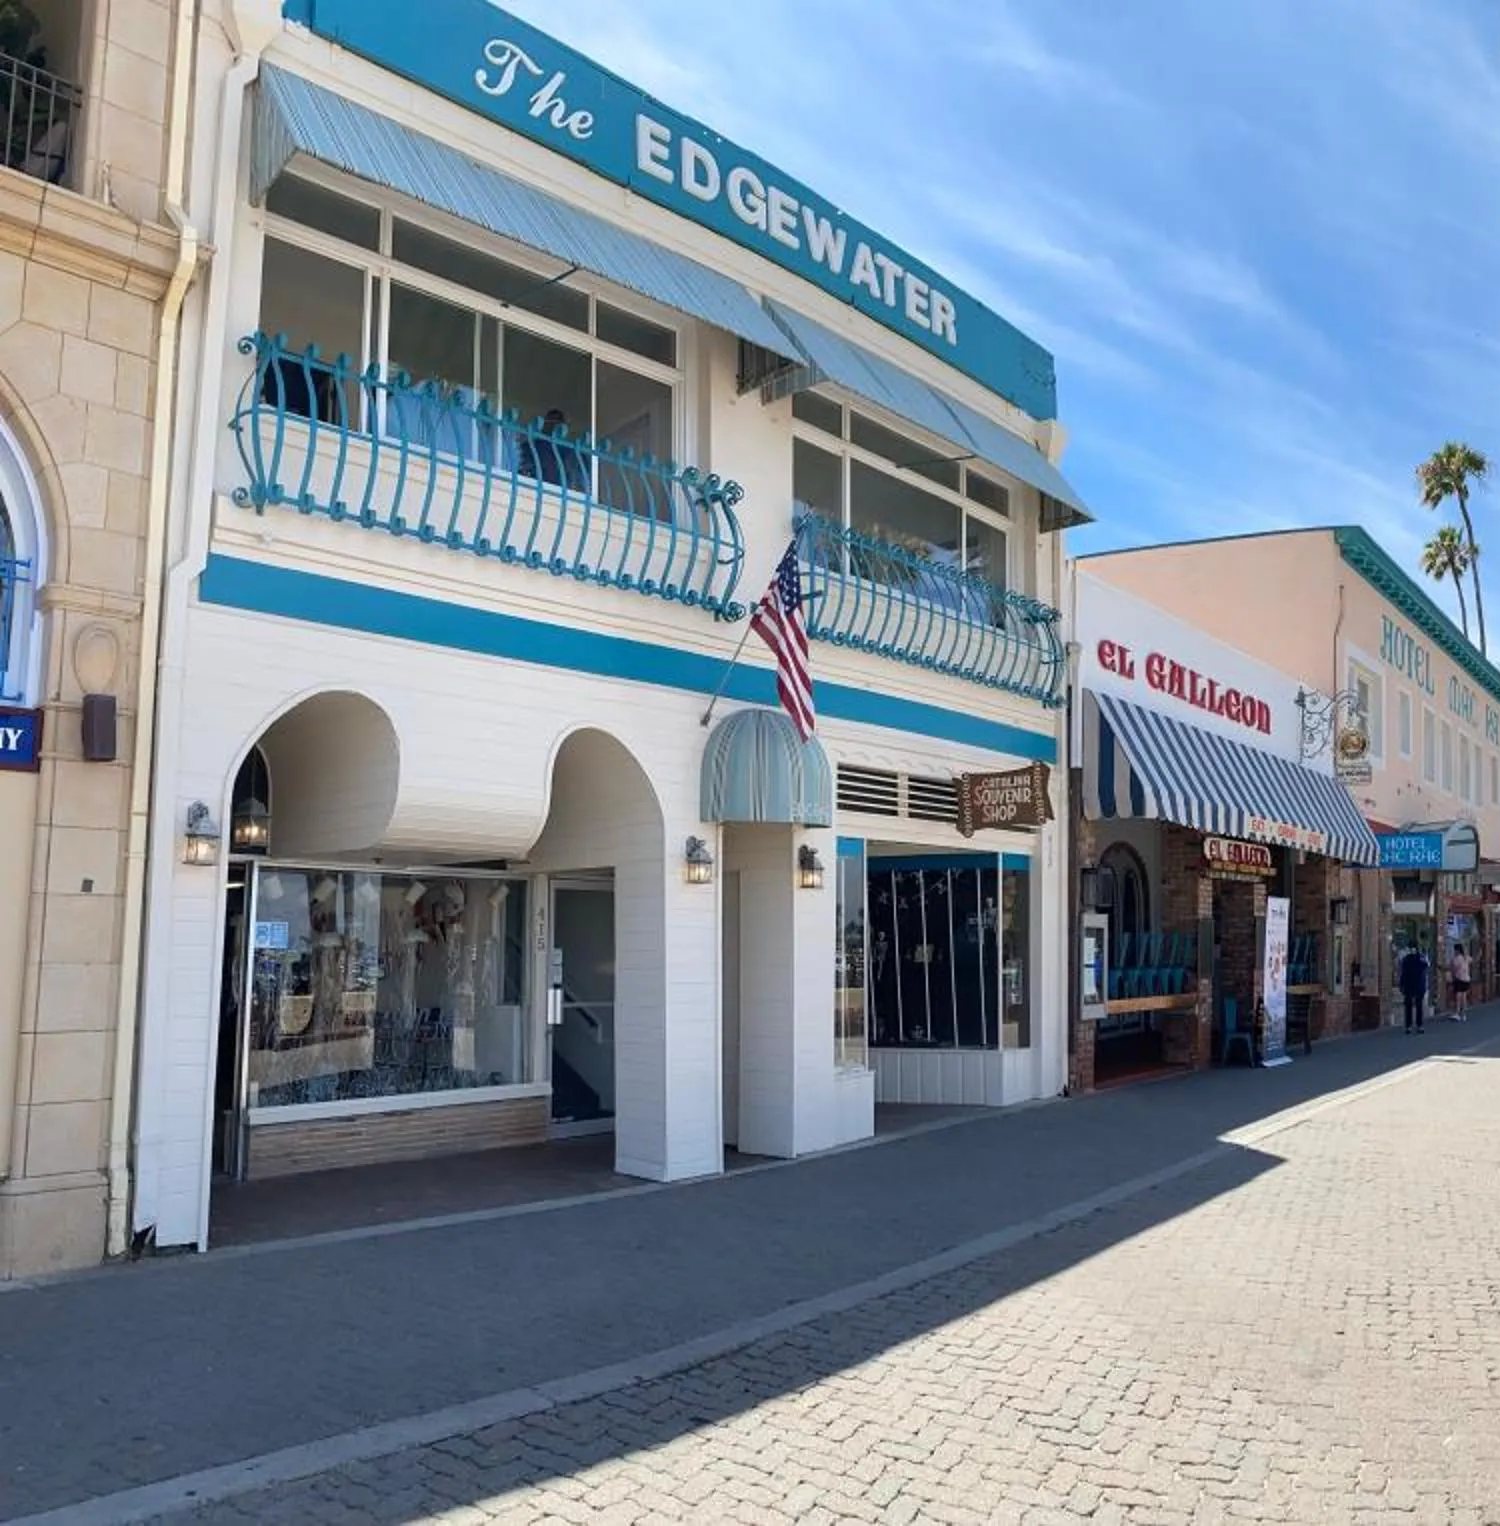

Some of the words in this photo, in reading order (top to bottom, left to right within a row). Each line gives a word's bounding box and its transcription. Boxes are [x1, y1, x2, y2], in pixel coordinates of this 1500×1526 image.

[475, 38, 593, 140] The
[635, 112, 958, 347] EDGEWATER
[1380, 614, 1435, 695] HOTEL
[1097, 639, 1135, 681] EL
[1145, 652, 1272, 735] GALLEON
[982, 775, 1031, 789] CATALINA
[974, 786, 1032, 806] SOUVENIR
[981, 804, 1017, 823] SHOP
[1385, 837, 1426, 849] HOTEL
[1381, 850, 1405, 863] AC
